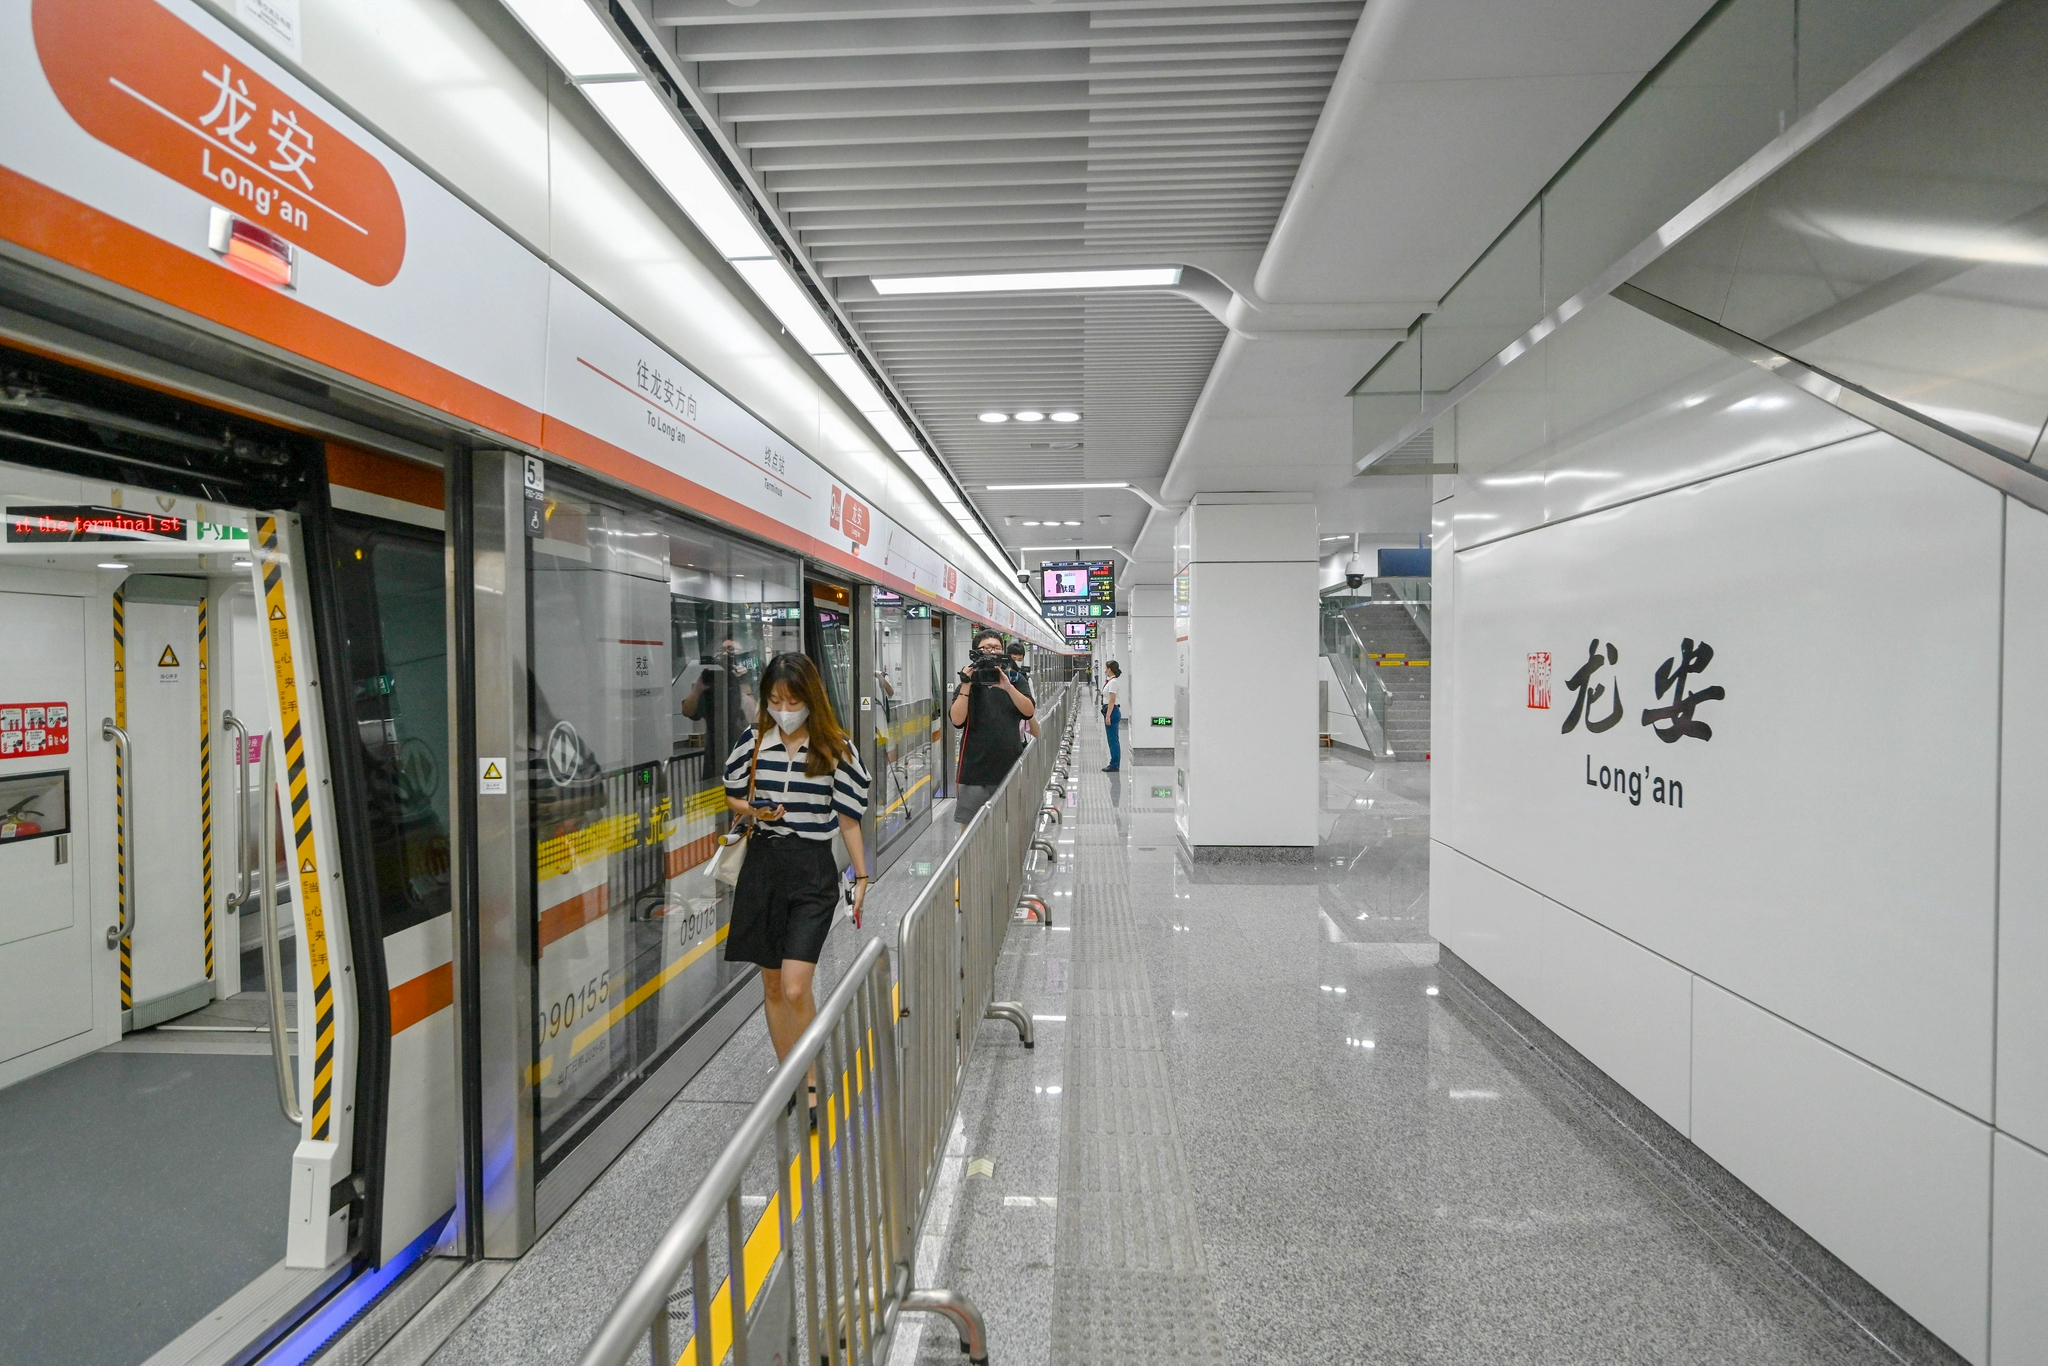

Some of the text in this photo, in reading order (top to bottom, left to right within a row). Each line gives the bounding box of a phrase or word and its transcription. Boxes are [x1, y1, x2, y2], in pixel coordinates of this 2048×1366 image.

[199, 63, 316, 191] 龙安
[202, 148, 308, 231] Long'an
[637, 359, 697, 422] 往龙安方向
[647, 410, 686, 444] To Long'an
[527, 460, 536, 485] 5
[764, 446, 785, 476] 终点站
[764, 477, 783, 497] Terminus
[37, 516, 68, 533] the
[75, 514, 155, 532] terminal
[160, 517, 180, 532] st
[279, 628, 298, 712] 当心夹手
[1561, 637, 1725, 744] 龙安
[1586, 754, 1683, 808] Long'an
[310, 881, 328, 965] 当心夹手
